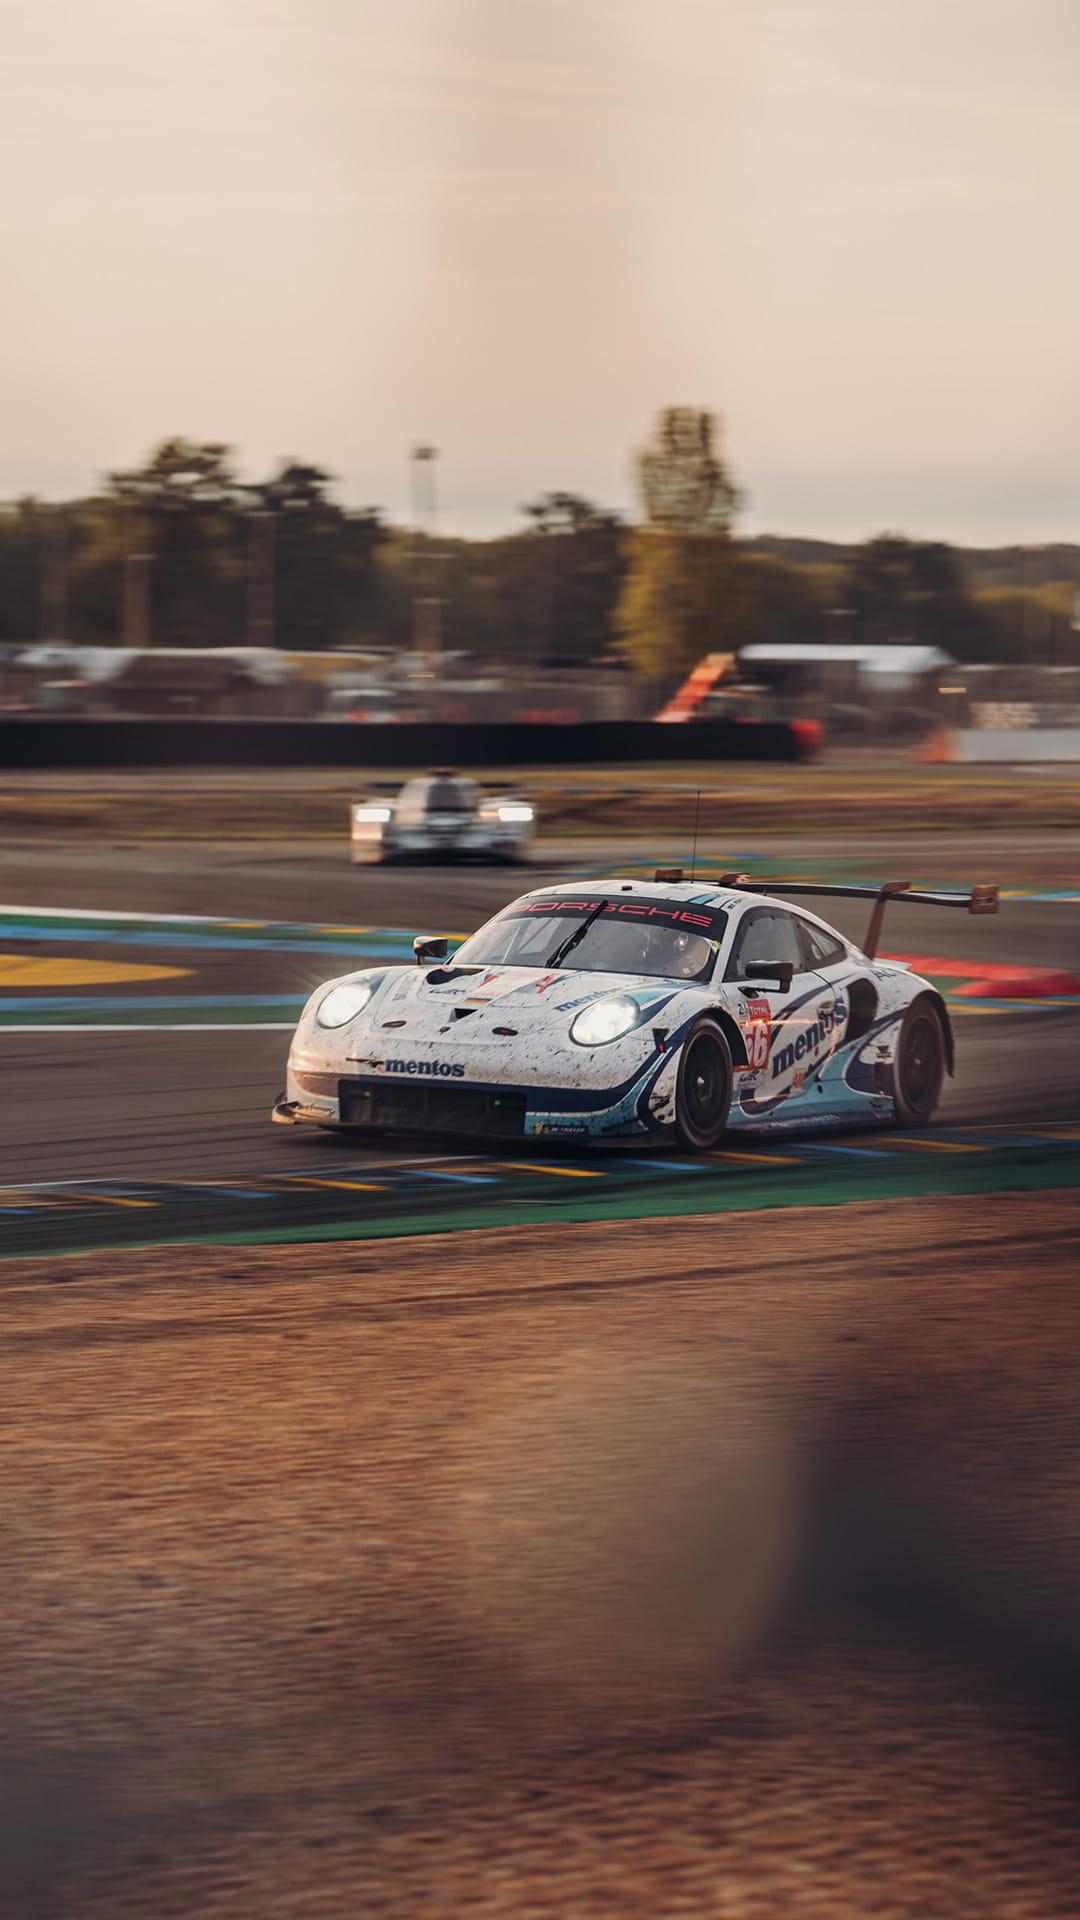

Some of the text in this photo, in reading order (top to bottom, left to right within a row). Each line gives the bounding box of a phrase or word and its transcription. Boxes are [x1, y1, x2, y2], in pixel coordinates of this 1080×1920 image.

[506, 902, 712, 928] PORSCHE
[552, 986, 622, 1012] ment
[750, 1006, 769, 1016] TOTAL
[384, 1059, 465, 1077] mentos
